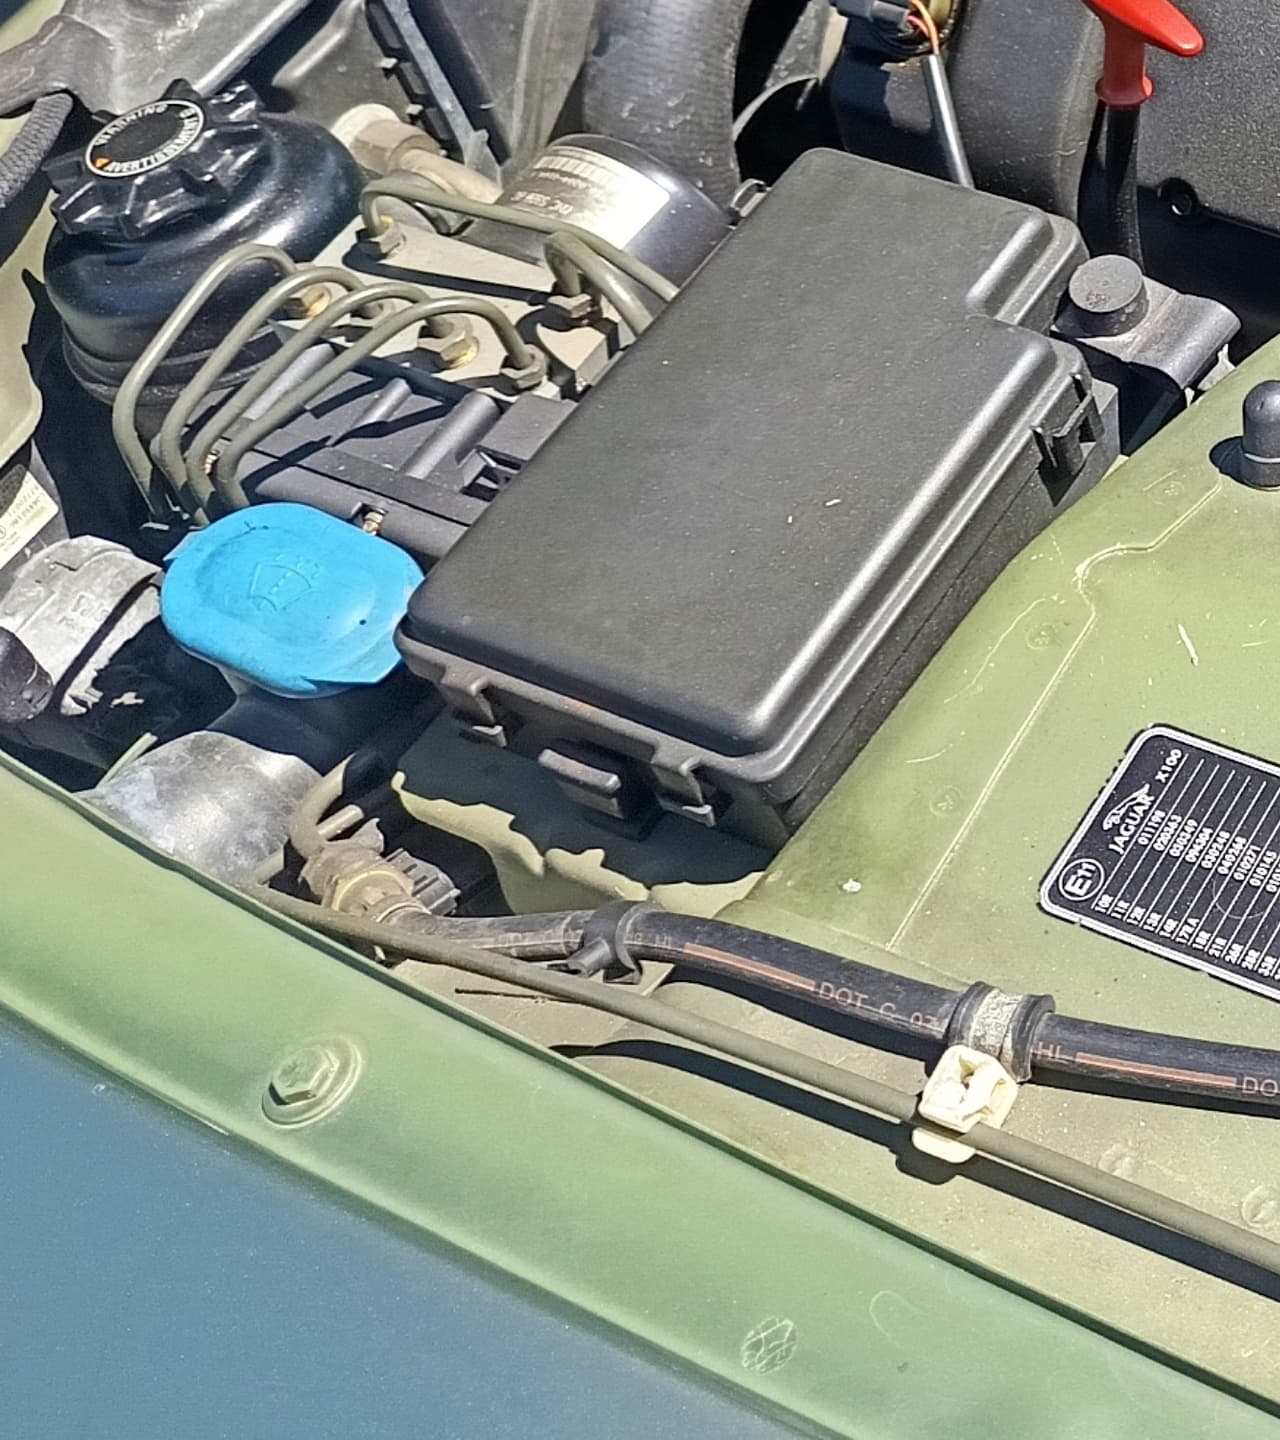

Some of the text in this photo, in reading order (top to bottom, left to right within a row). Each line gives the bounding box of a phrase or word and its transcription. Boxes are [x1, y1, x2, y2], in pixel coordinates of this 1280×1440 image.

[1156, 749, 1182, 782] X100
[1108, 792, 1156, 855] JAGUAR
[1065, 862, 1096, 895] E11
[1111, 900, 1130, 918] 11R
[818, 981, 869, 1009] DOT
